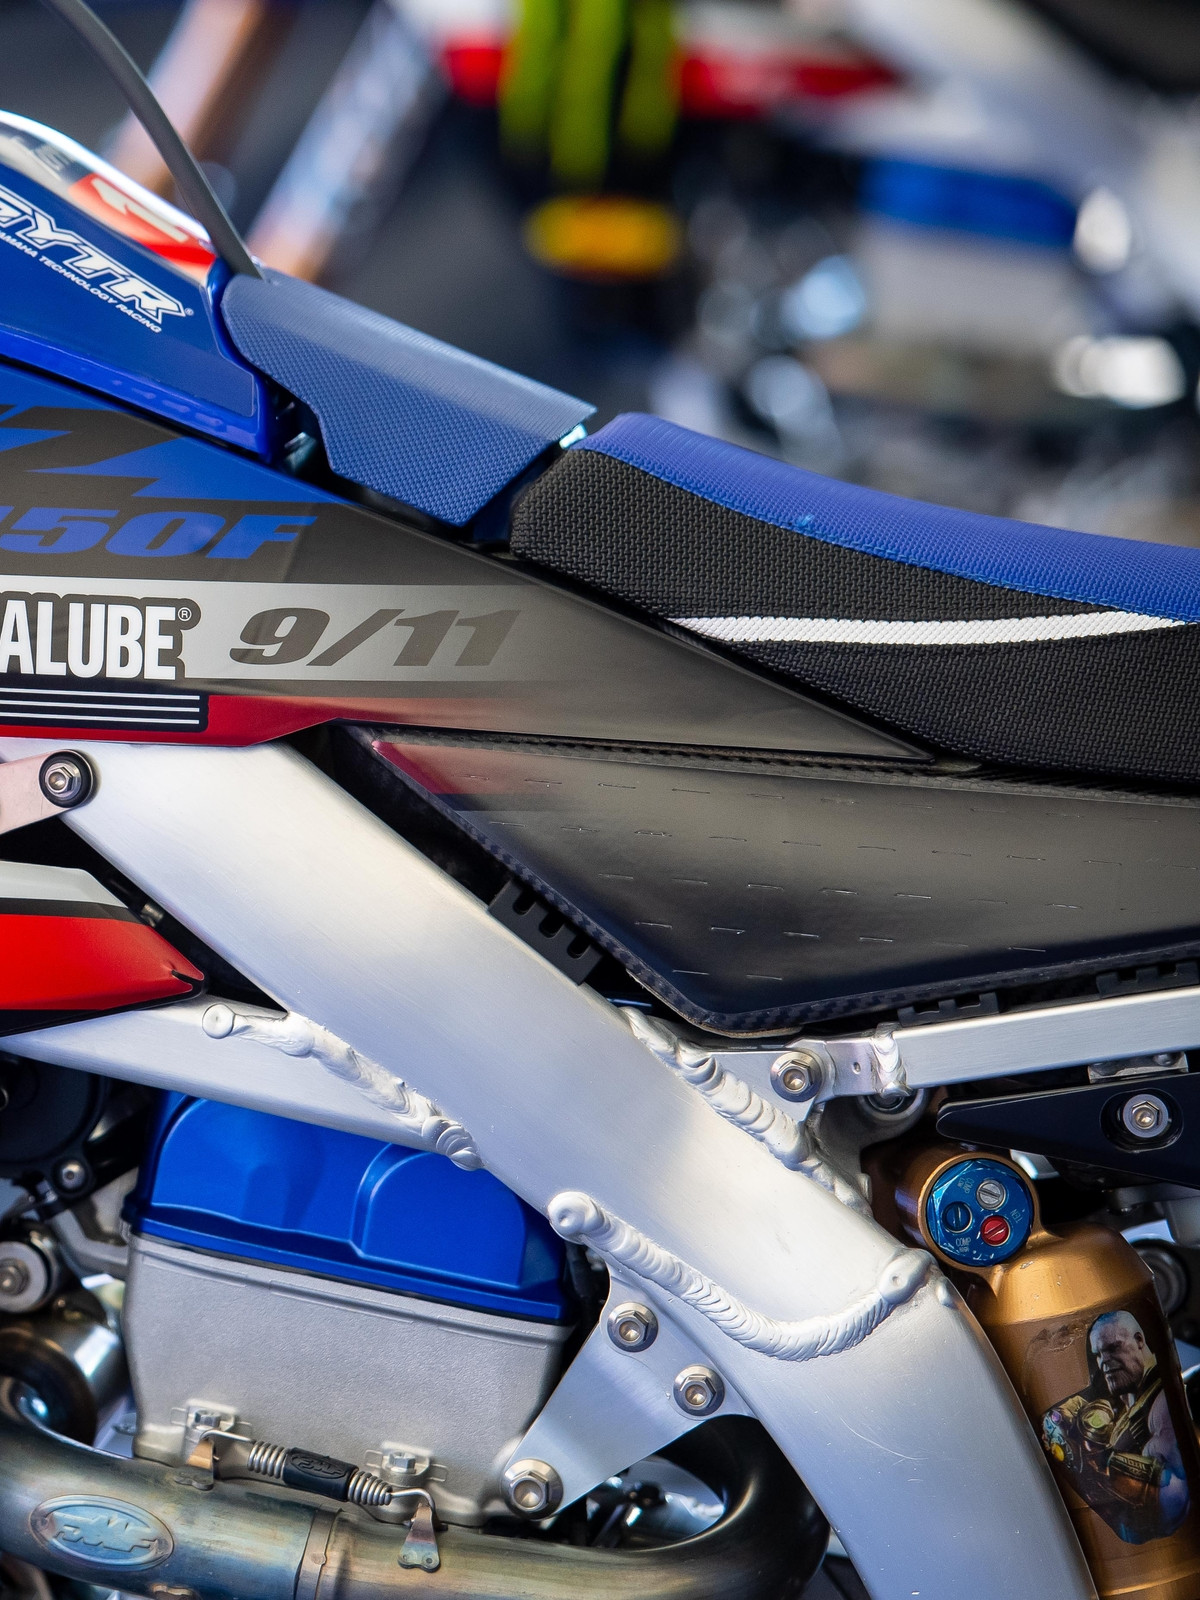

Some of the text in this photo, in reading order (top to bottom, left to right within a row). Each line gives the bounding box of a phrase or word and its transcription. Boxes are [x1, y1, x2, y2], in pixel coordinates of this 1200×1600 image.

[38, 254, 118, 306] TECHNOLOGY
[115, 302, 162, 334] RACING
[228, 607, 522, 668] 9/11
